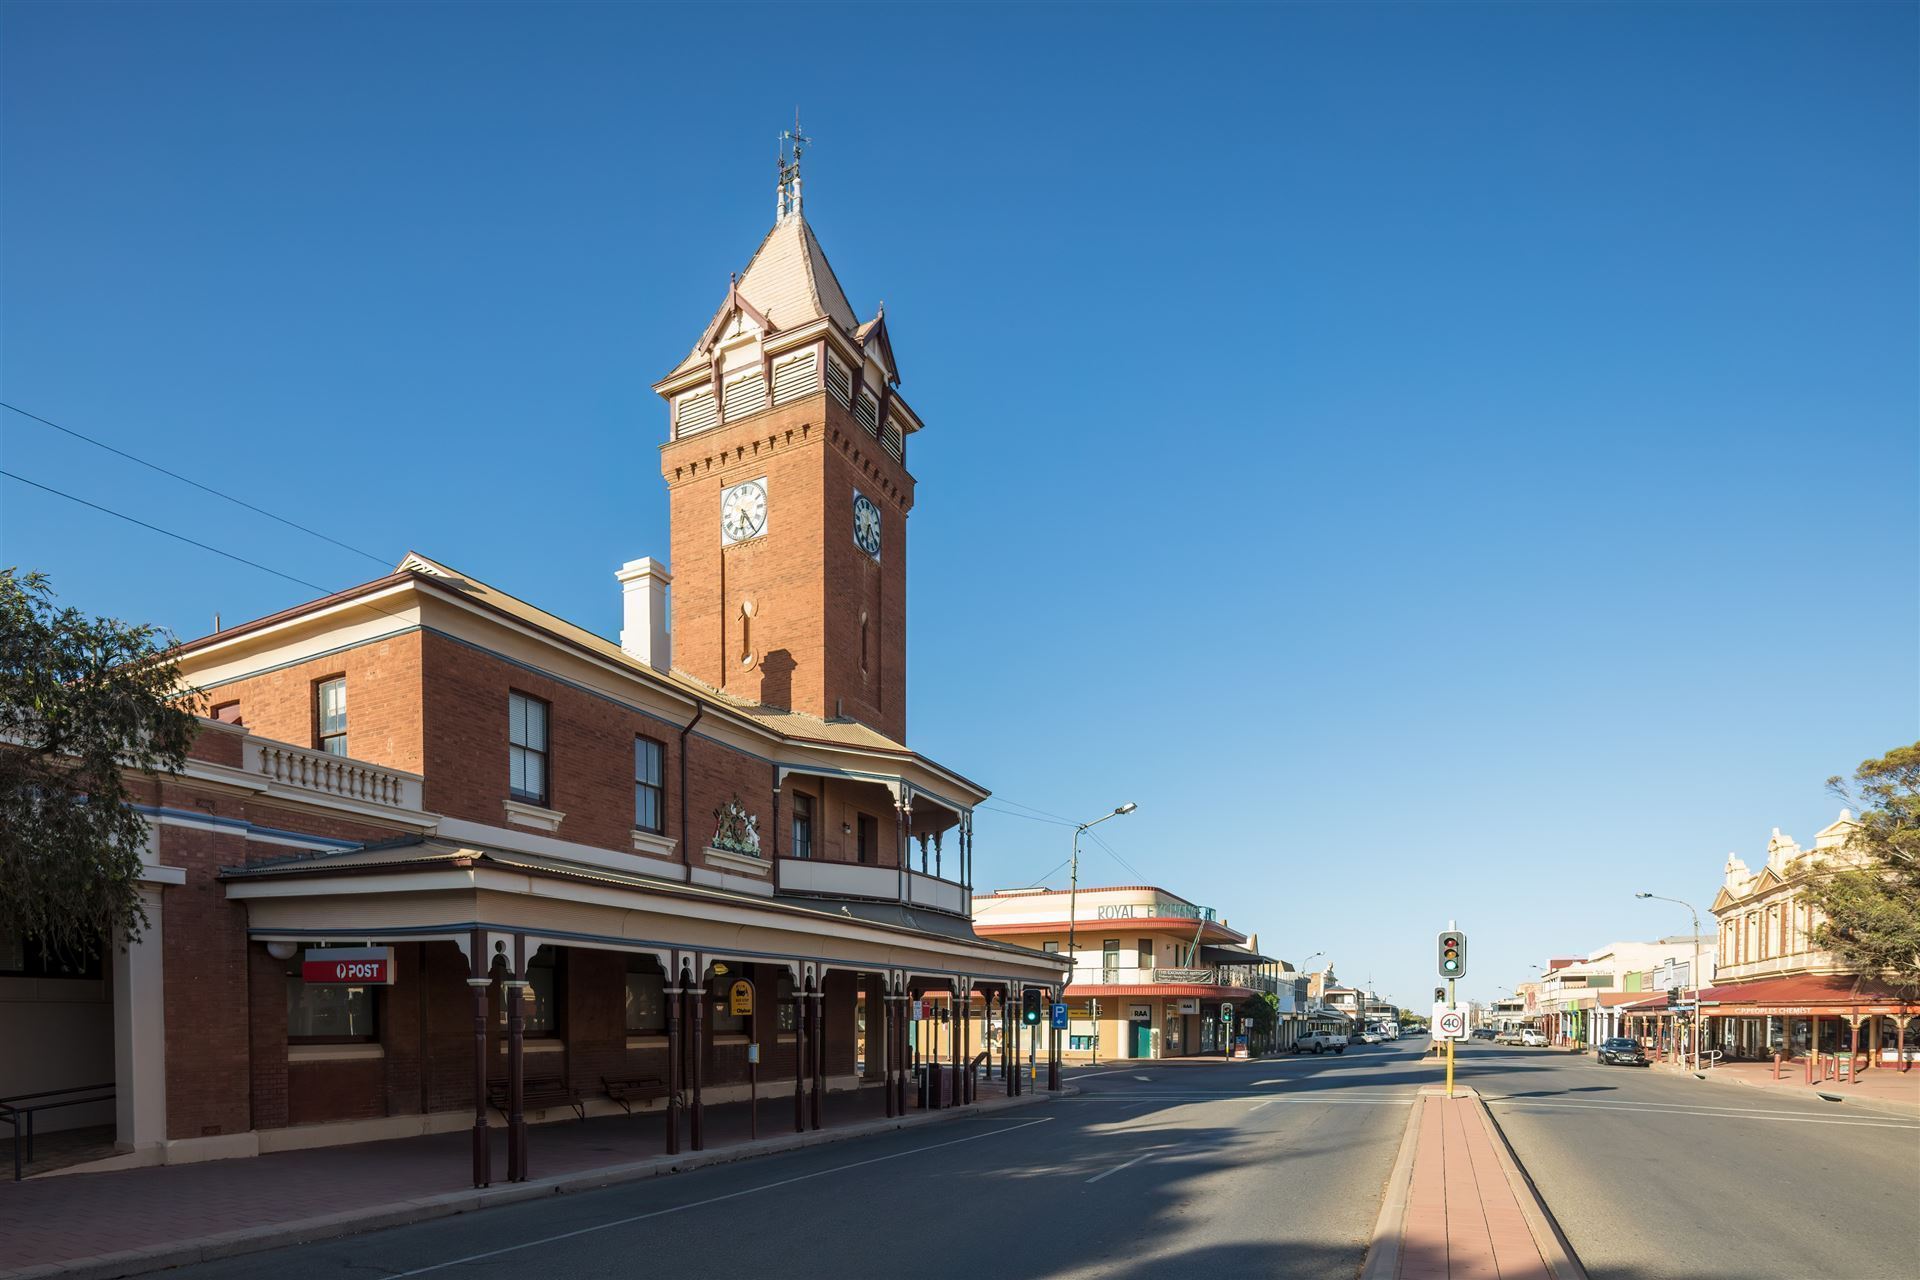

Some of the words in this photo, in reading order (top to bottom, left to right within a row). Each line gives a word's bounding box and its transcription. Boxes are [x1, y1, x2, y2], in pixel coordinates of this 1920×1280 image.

[1098, 905, 1137, 919] ROYAL
[348, 963, 379, 978] POST
[1055, 1006, 1065, 1018] P
[1778, 1007, 1812, 1016] CHEMIST
[1443, 1018, 1460, 1028] 40
